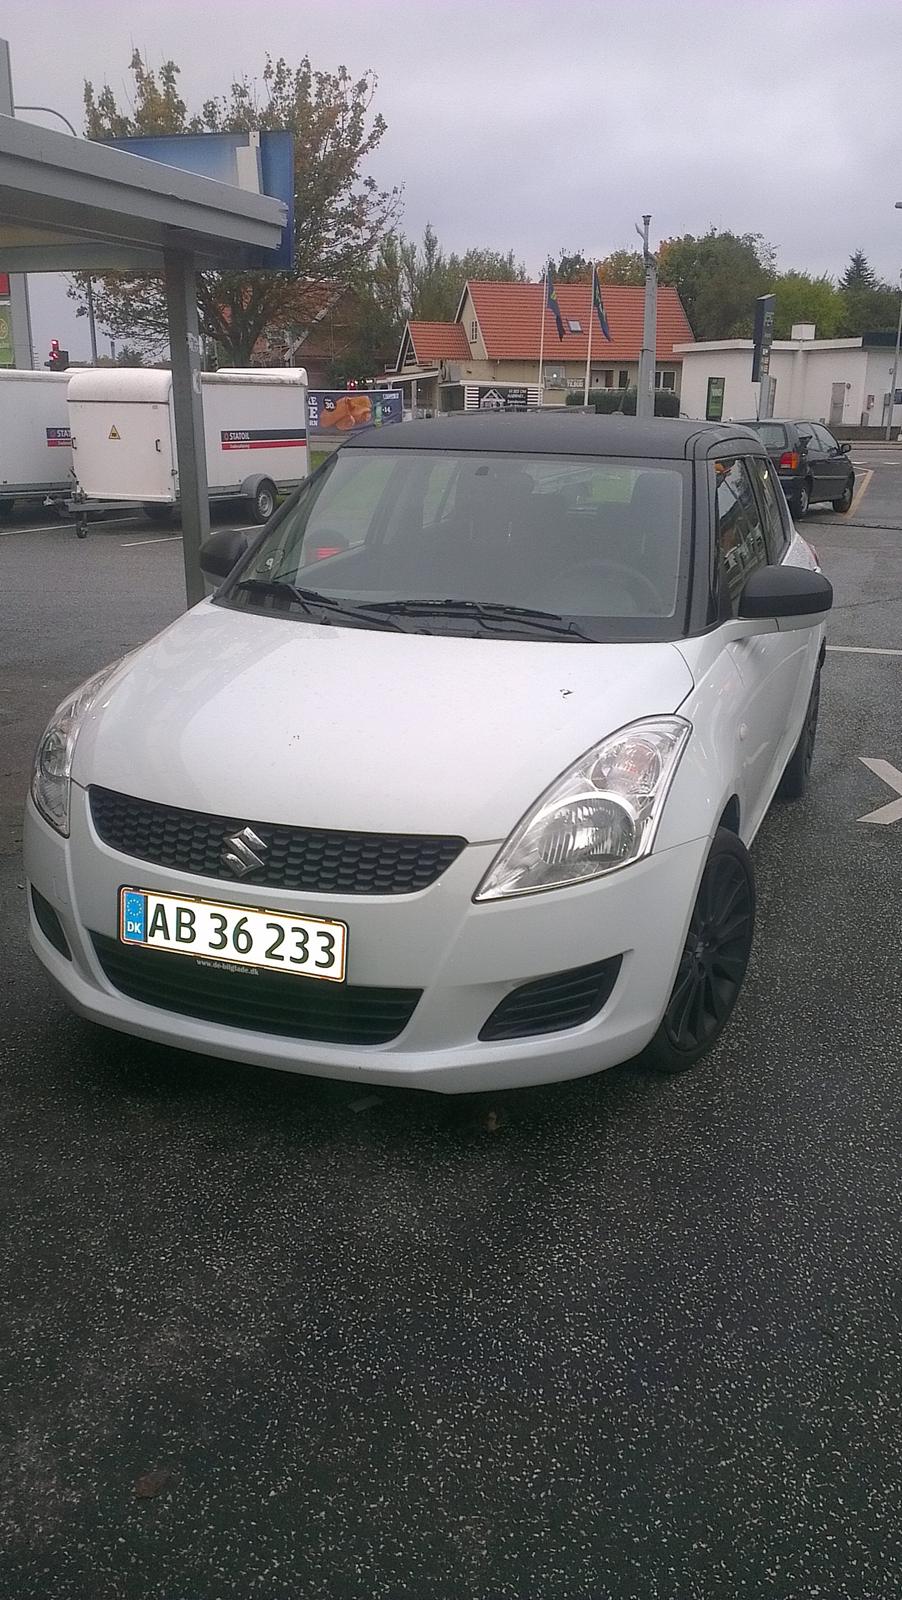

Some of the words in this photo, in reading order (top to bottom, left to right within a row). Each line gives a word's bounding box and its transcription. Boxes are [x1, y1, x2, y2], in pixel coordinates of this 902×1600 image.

[229, 431, 250, 441] STATOIL
[127, 921, 142, 934] DK
[148, 903, 197, 944] AB
[208, 912, 254, 955] 36
[264, 922, 336, 969] 233
